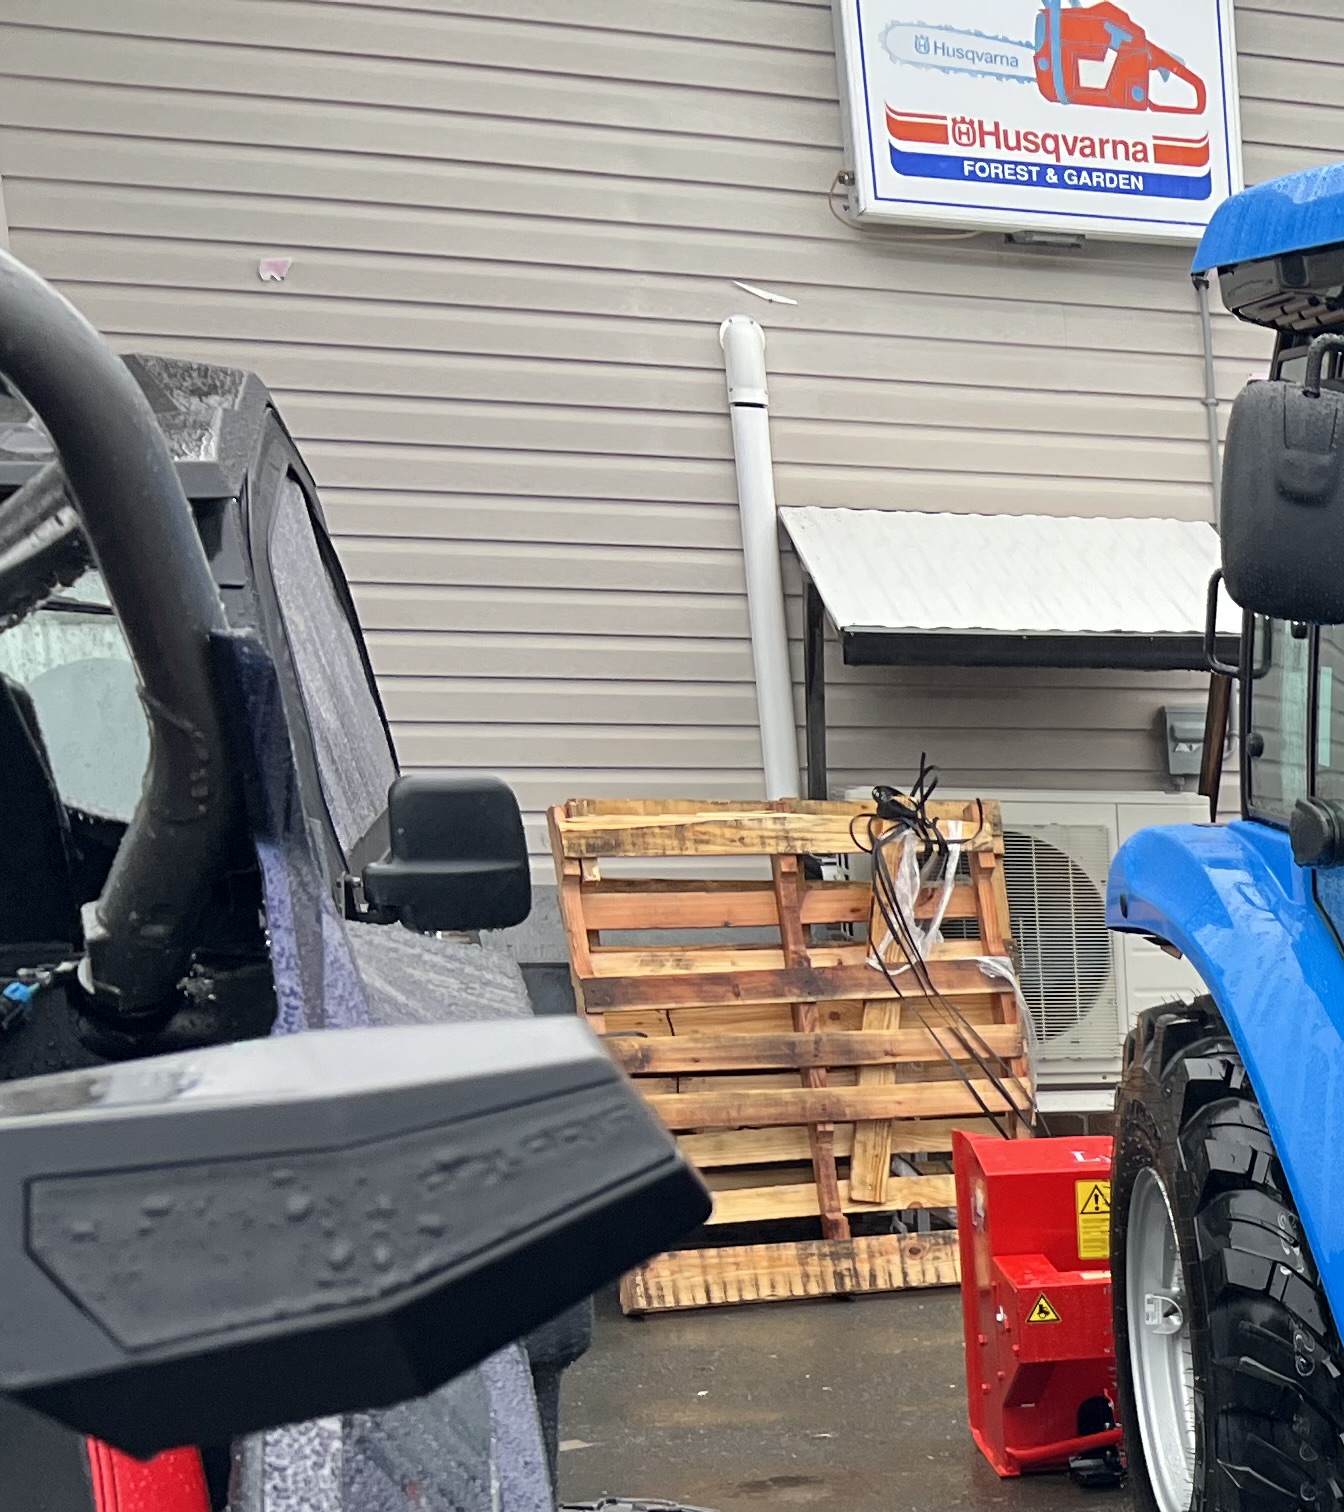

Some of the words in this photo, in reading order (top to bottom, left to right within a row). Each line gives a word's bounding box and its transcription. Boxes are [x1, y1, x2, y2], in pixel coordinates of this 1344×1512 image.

[934, 40, 1019, 68] Husqvarna
[978, 119, 1149, 163] Husqvarna
[963, 160, 1040, 182] FOREST
[1045, 167, 1059, 184] &
[1063, 170, 1144, 191] GARDEN
